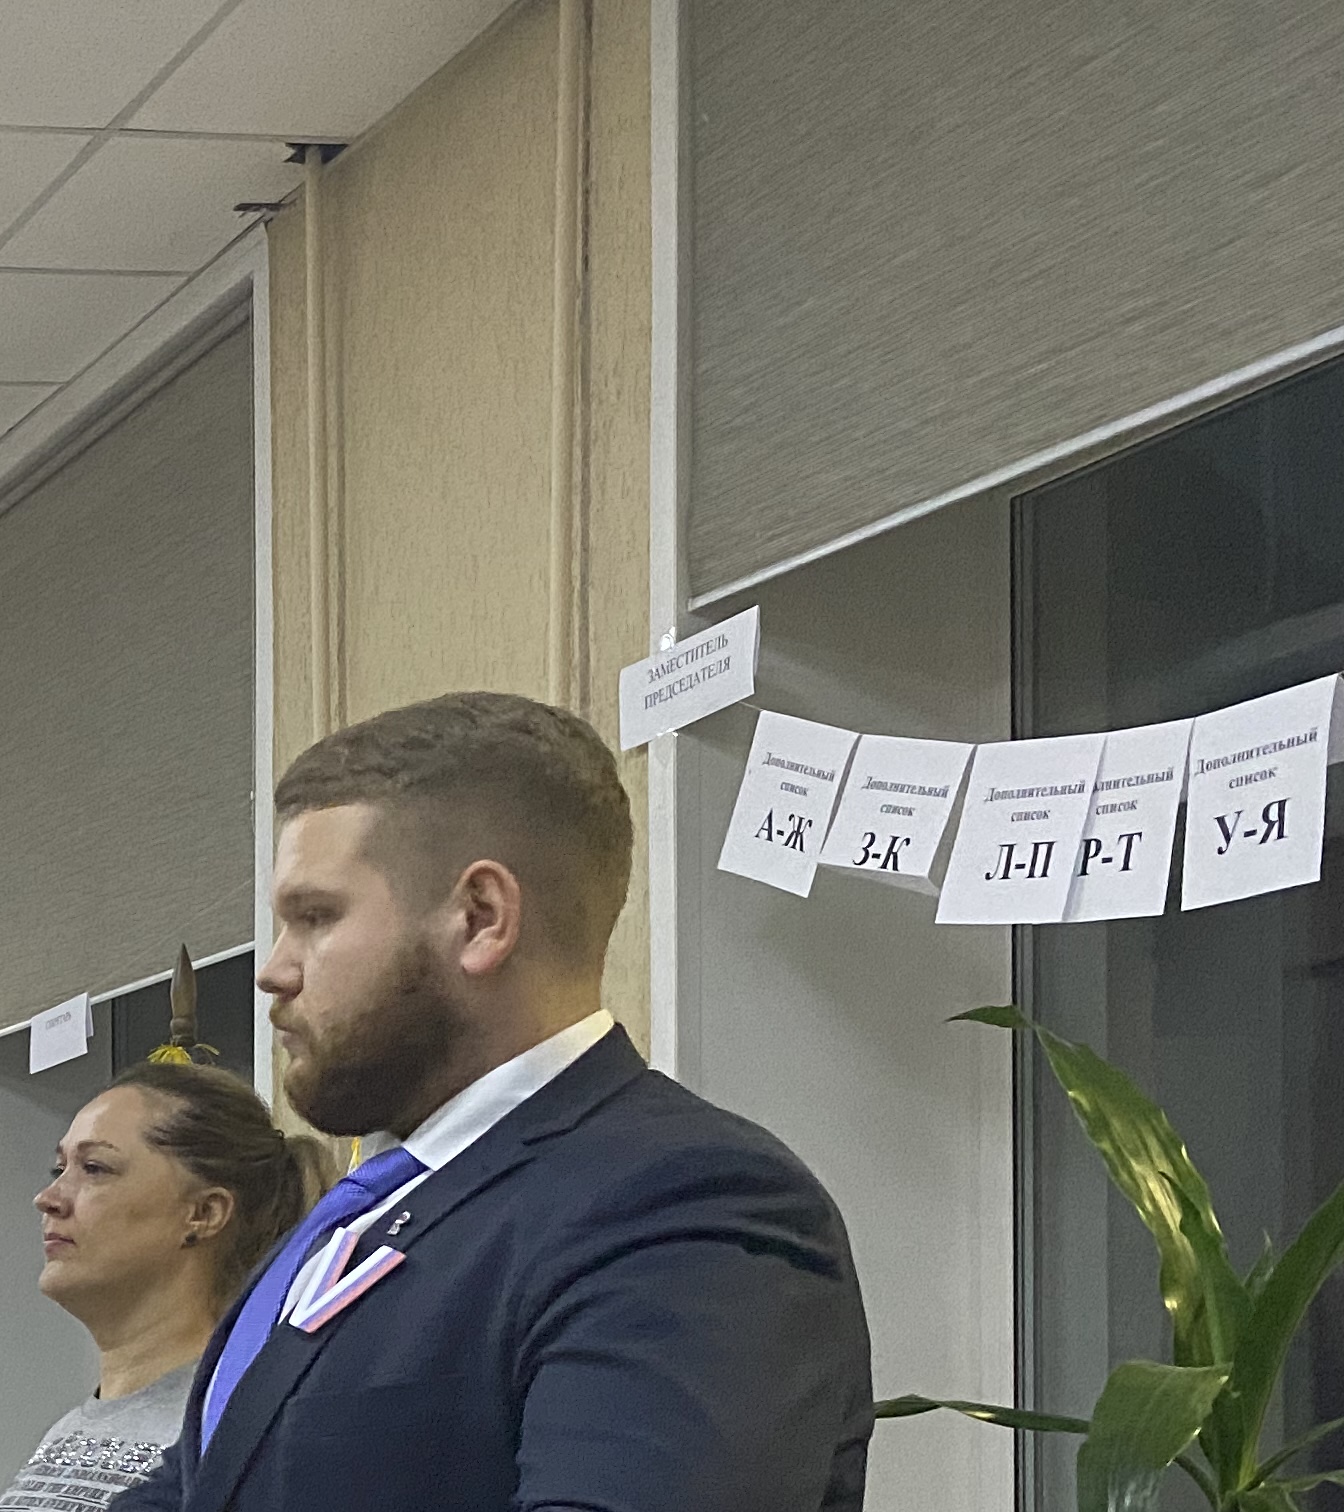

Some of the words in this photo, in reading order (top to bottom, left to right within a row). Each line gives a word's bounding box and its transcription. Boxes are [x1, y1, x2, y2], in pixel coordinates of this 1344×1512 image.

[647, 633, 729, 684] ЗАМЕСТИТЕЛЬ
[644, 656, 732, 710] ПРЕДСЕДАТЕЛЯ
[762, 752, 836, 783] Дополнительный
[1194, 727, 1318, 777] Дополнительный
[780, 780, 809, 797] список
[862, 776, 950, 799] Дополнительный
[984, 780, 1086, 803] Дополнительный
[1092, 766, 1174, 794] лнительный
[1229, 766, 1278, 790] список
[880, 803, 916, 817] список
[1011, 808, 1051, 823] список
[1096, 799, 1138, 816] список
[754, 807, 813, 854] А-Ж
[1213, 797, 1291, 856] У-Я
[852, 831, 911, 872] З-К
[984, 840, 1058, 881] Л-П
[1077, 831, 1143, 878] Р-Т
